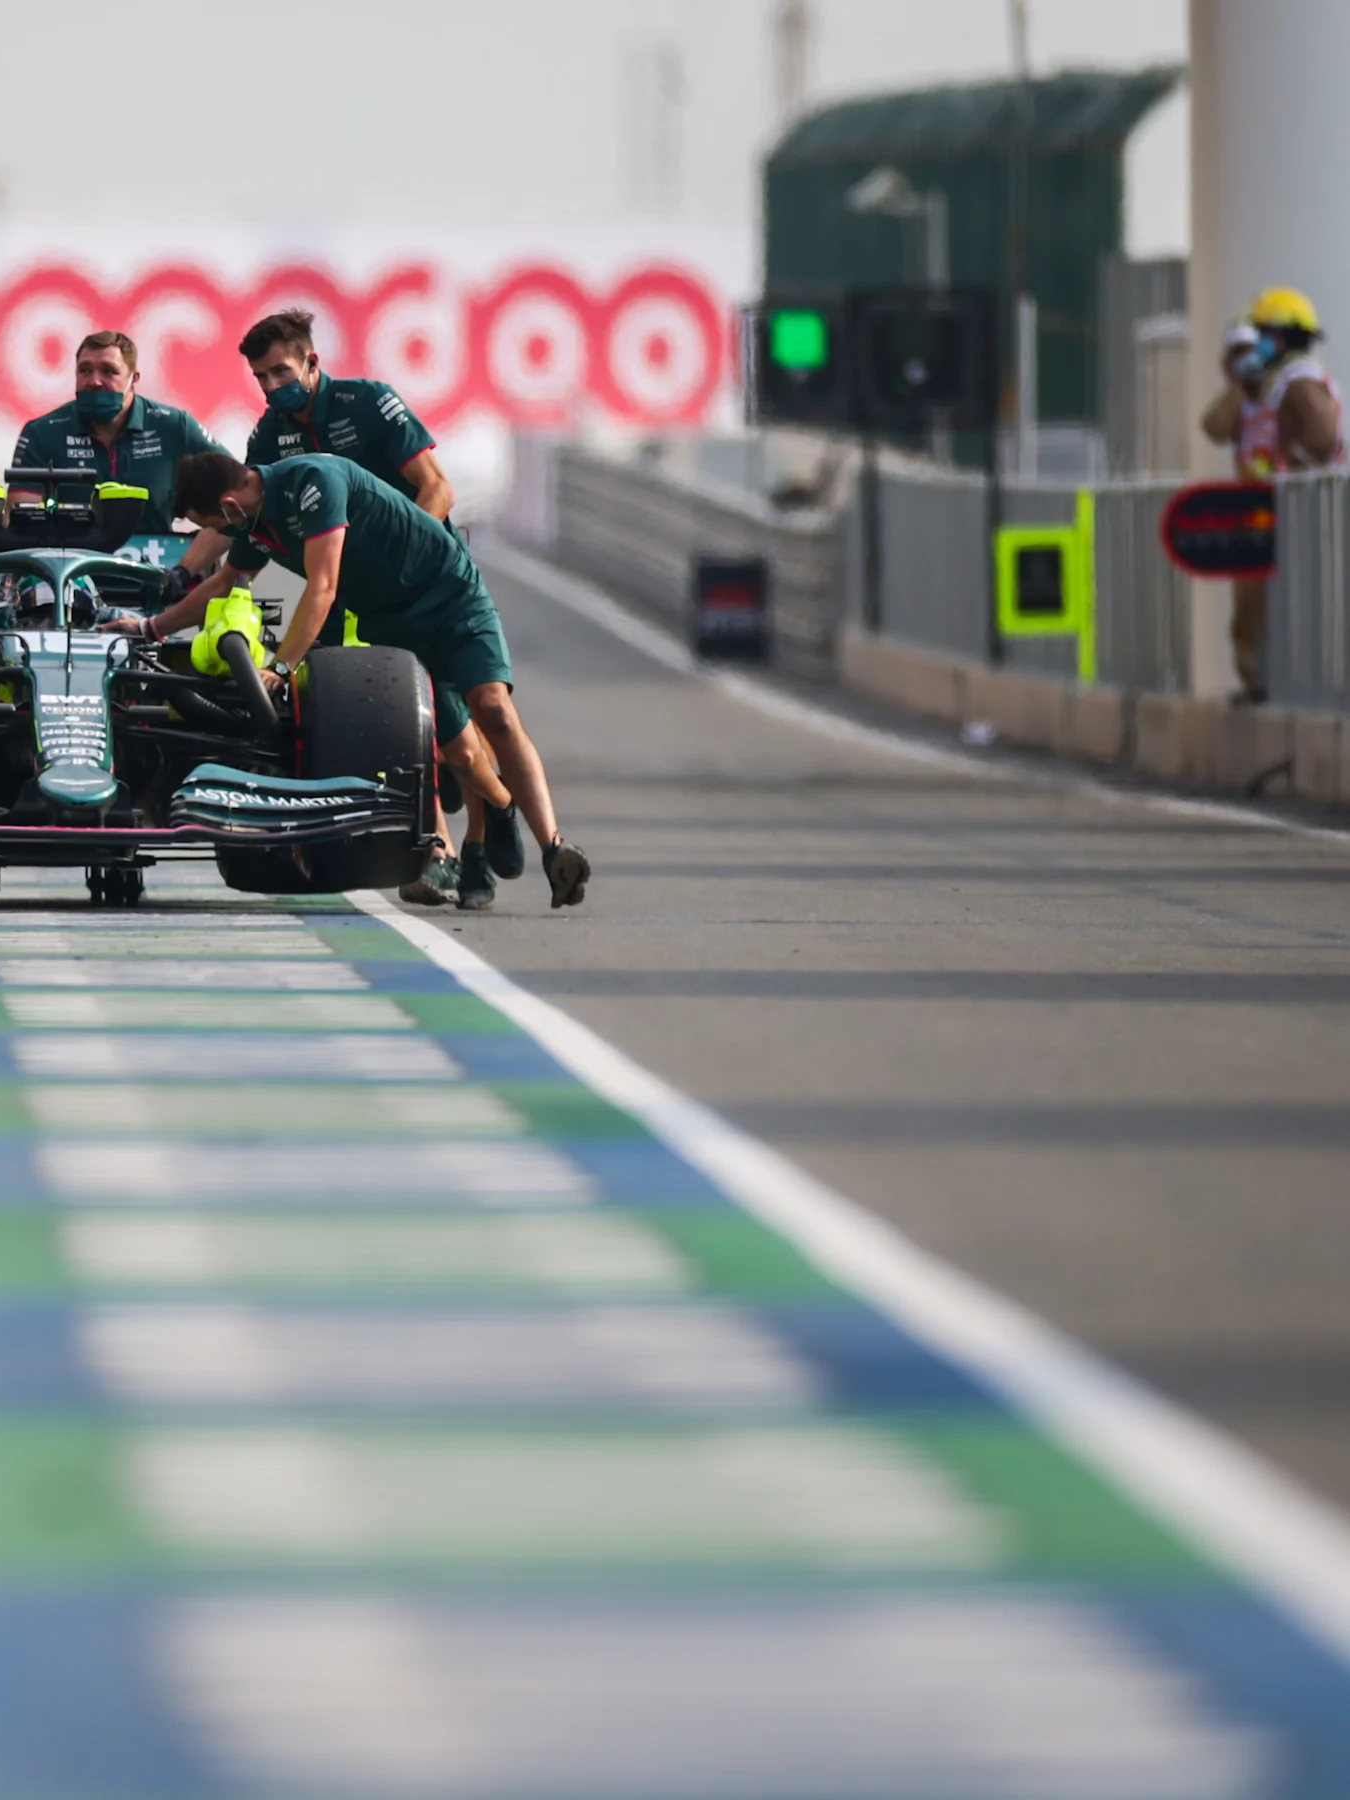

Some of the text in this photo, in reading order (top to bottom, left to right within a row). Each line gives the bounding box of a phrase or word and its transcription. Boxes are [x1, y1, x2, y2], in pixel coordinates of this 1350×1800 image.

[277, 433, 303, 446] BWT
[39, 694, 102, 704] BWT
[41, 706, 103, 714] PERONI
[40, 728, 107, 738] NetApp
[193, 787, 354, 807] ASTON MARTIN
